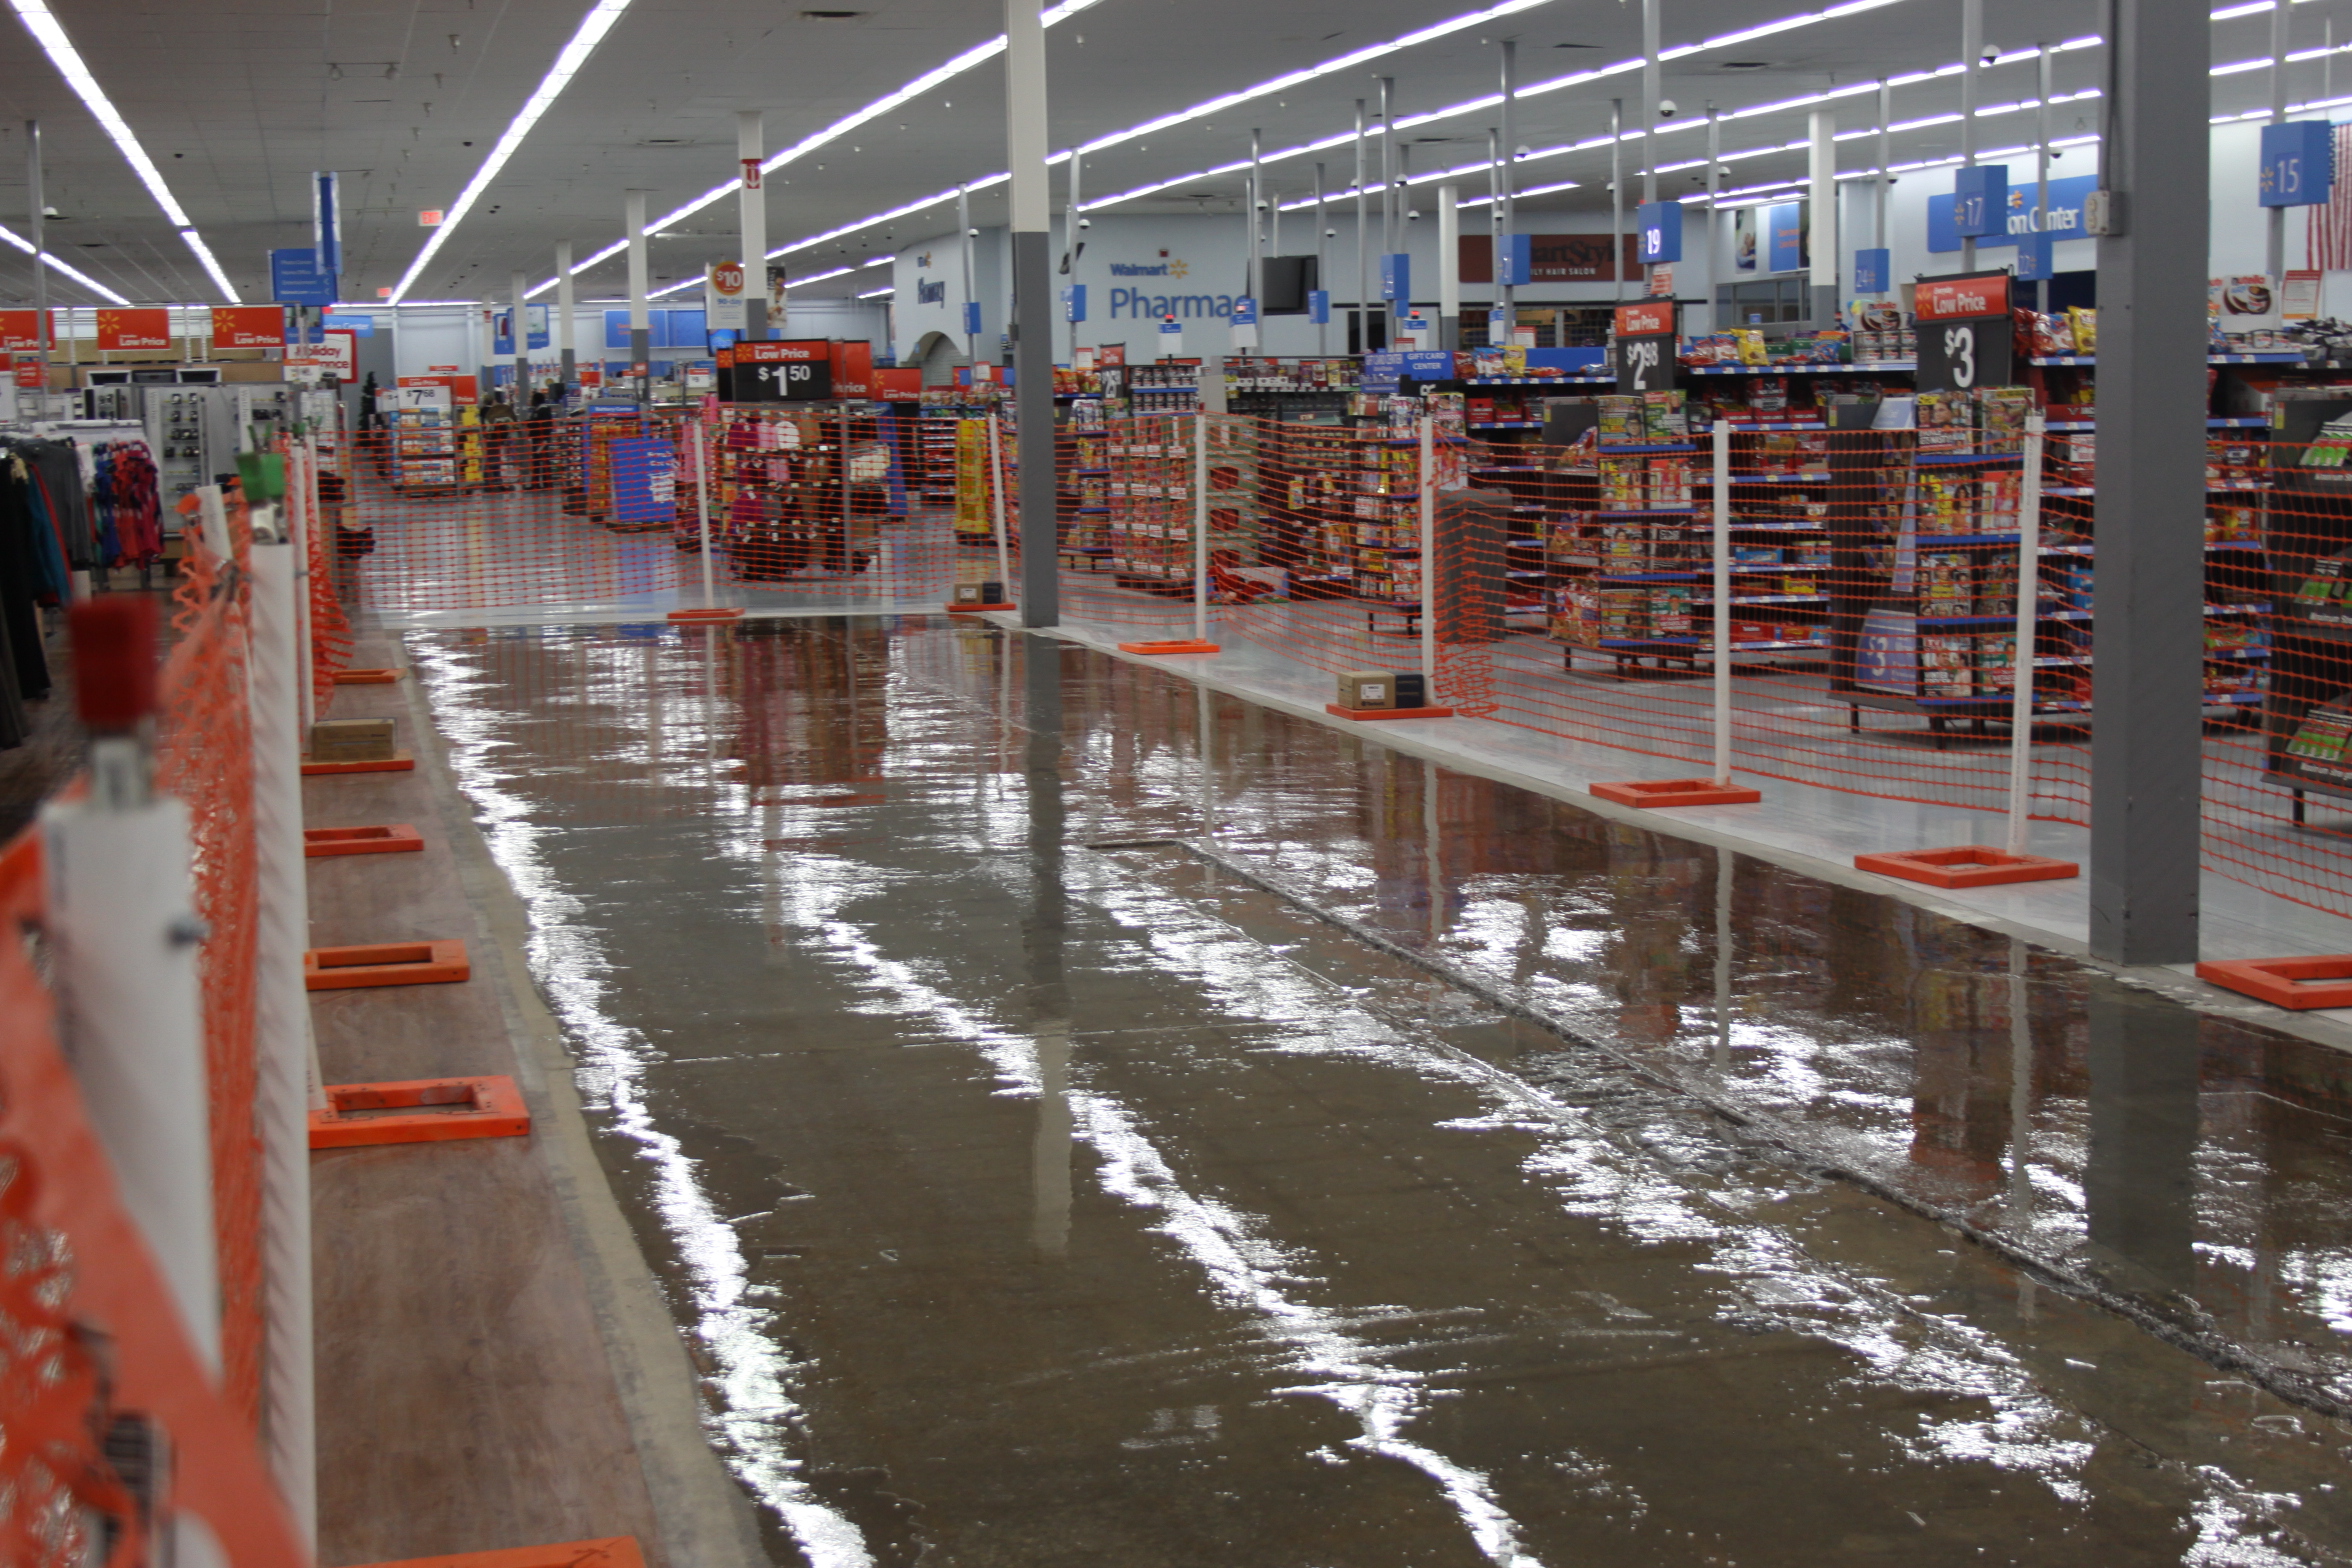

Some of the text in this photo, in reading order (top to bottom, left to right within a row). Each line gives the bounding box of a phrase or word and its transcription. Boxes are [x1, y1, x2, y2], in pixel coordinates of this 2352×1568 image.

[2277, 158, 2300, 193] 15
[1965, 197, 1983, 226] 17
[2029, 206, 2080, 233] Cnter
[1646, 229, 1661, 254] 19
[1110, 263, 1169, 276] Walmart
[1568, 267, 1596, 275] SALON
[716, 270, 742, 287] $10
[1933, 291, 1986, 314] Low Price
[1626, 314, 1660, 331] Low Price
[119, 337, 166, 346] Low Price
[234, 336, 281, 345] Low Price
[755, 348, 811, 360] Low Price
[1407, 352, 1447, 360] GIFT CARD
[1944, 326, 1975, 388] $3
[1412, 362, 1442, 370] CENTER
[883, 391, 919, 399] Low Price
